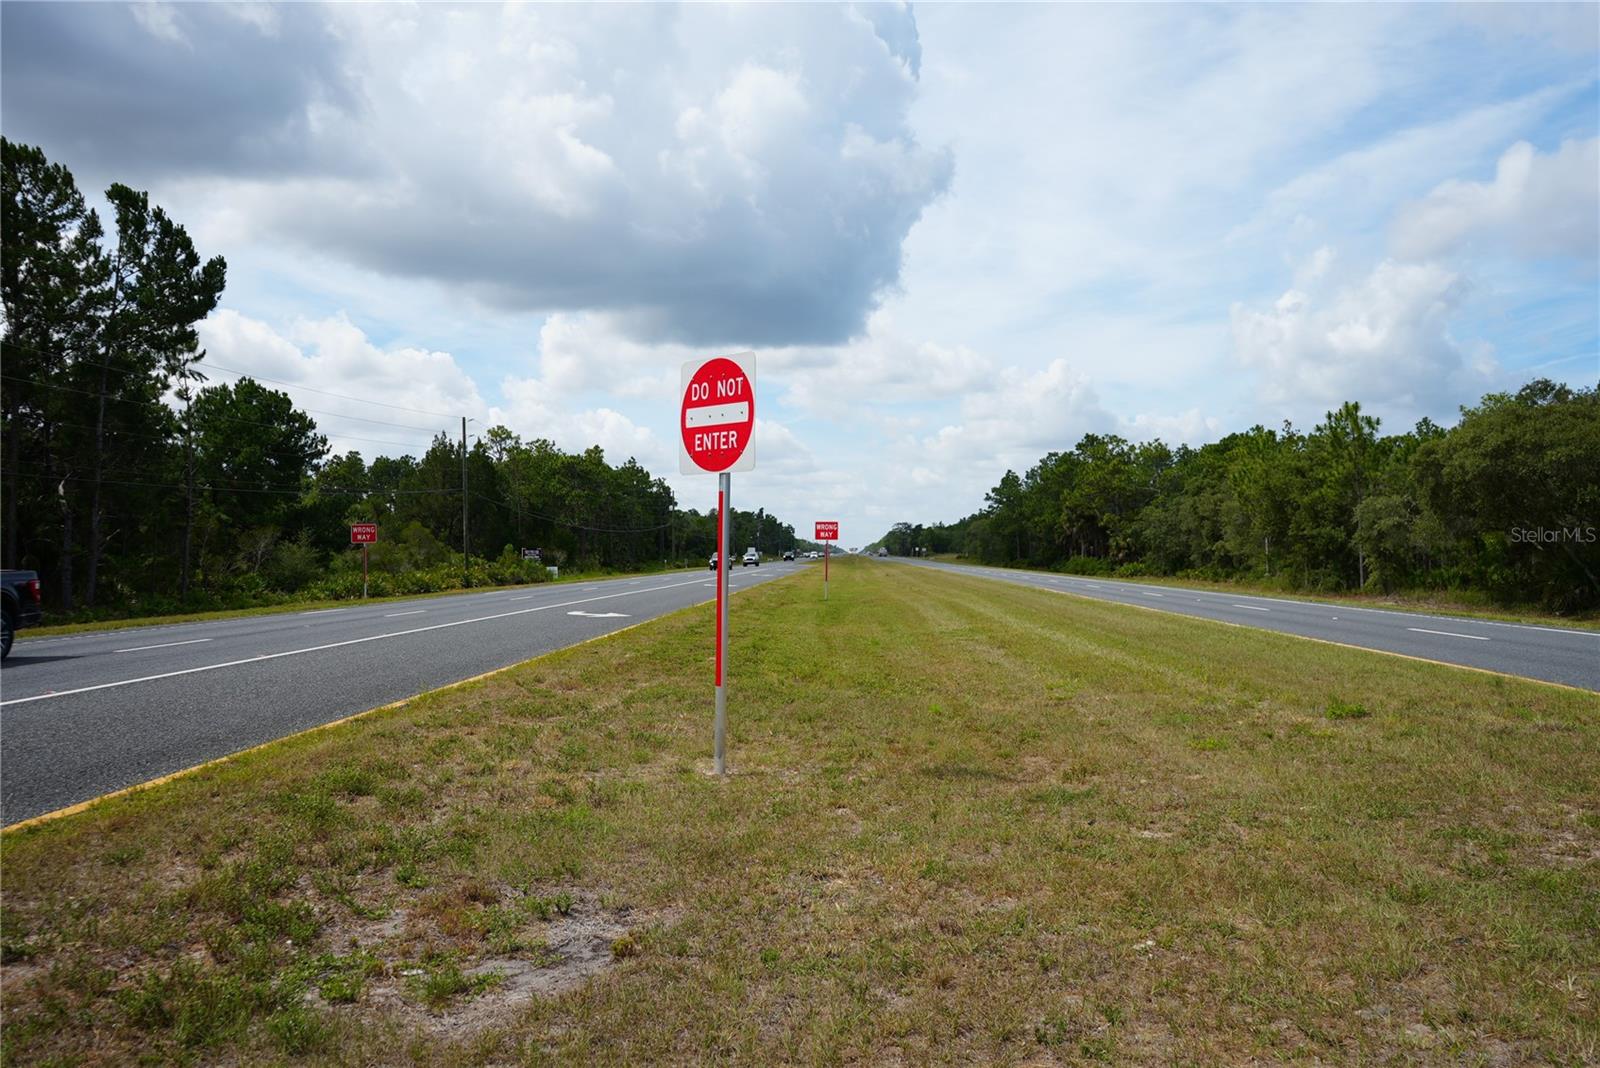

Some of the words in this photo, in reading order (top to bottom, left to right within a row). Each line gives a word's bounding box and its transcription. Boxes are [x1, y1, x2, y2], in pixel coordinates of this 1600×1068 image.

[691, 382, 709, 401] DO
[717, 377, 744, 398] NOT
[694, 430, 738, 452] ENTER
